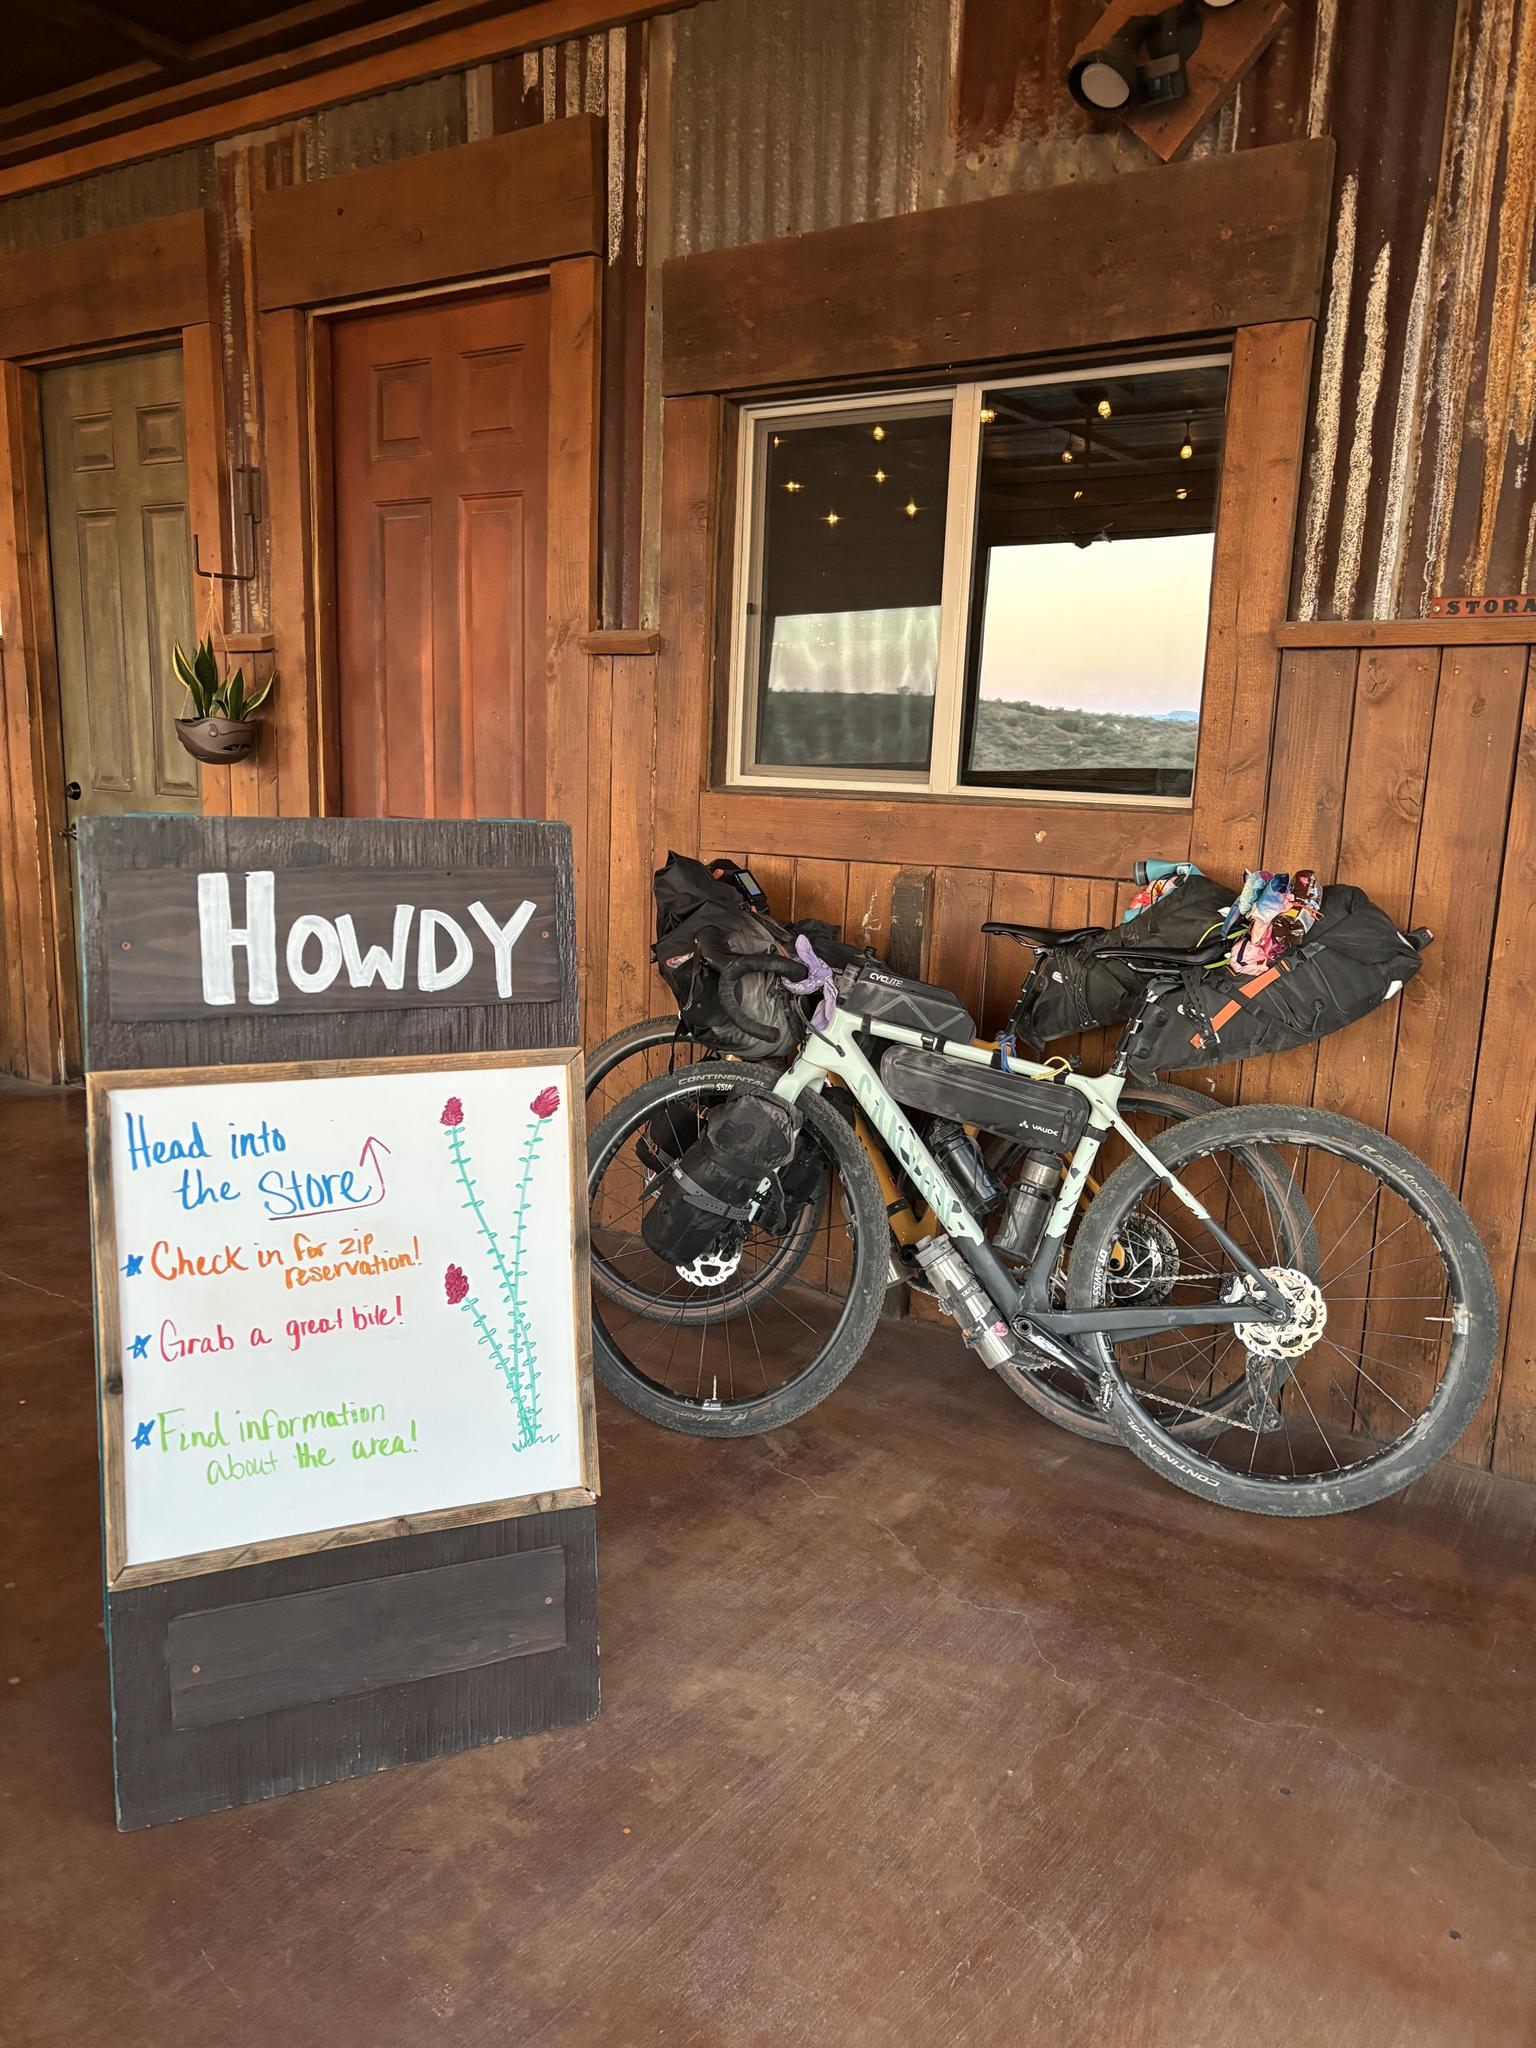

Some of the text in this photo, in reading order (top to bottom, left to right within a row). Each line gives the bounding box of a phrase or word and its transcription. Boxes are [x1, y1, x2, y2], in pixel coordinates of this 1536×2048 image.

[197, 870, 537, 1006] HOWDY
[869, 972, 903, 987] CYCLITE
[679, 1074, 768, 1089] CONTINENTAL
[125, 1112, 286, 1170] Head into
[1032, 1124, 1059, 1137] VAUDE
[173, 1169, 373, 1215] the Store
[151, 1240, 249, 1281] Check
[254, 1242, 283, 1269] in
[293, 1232, 328, 1262] for
[284, 1235, 424, 1289] reservation!
[1092, 1248, 1108, 1296] DT SWISS
[159, 1295, 405, 1362] Grab a great bite!
[156, 1402, 386, 1452] Find information
[1127, 1415, 1220, 1487] CONTINENTAL
[206, 1420, 419, 1486] about the area!
